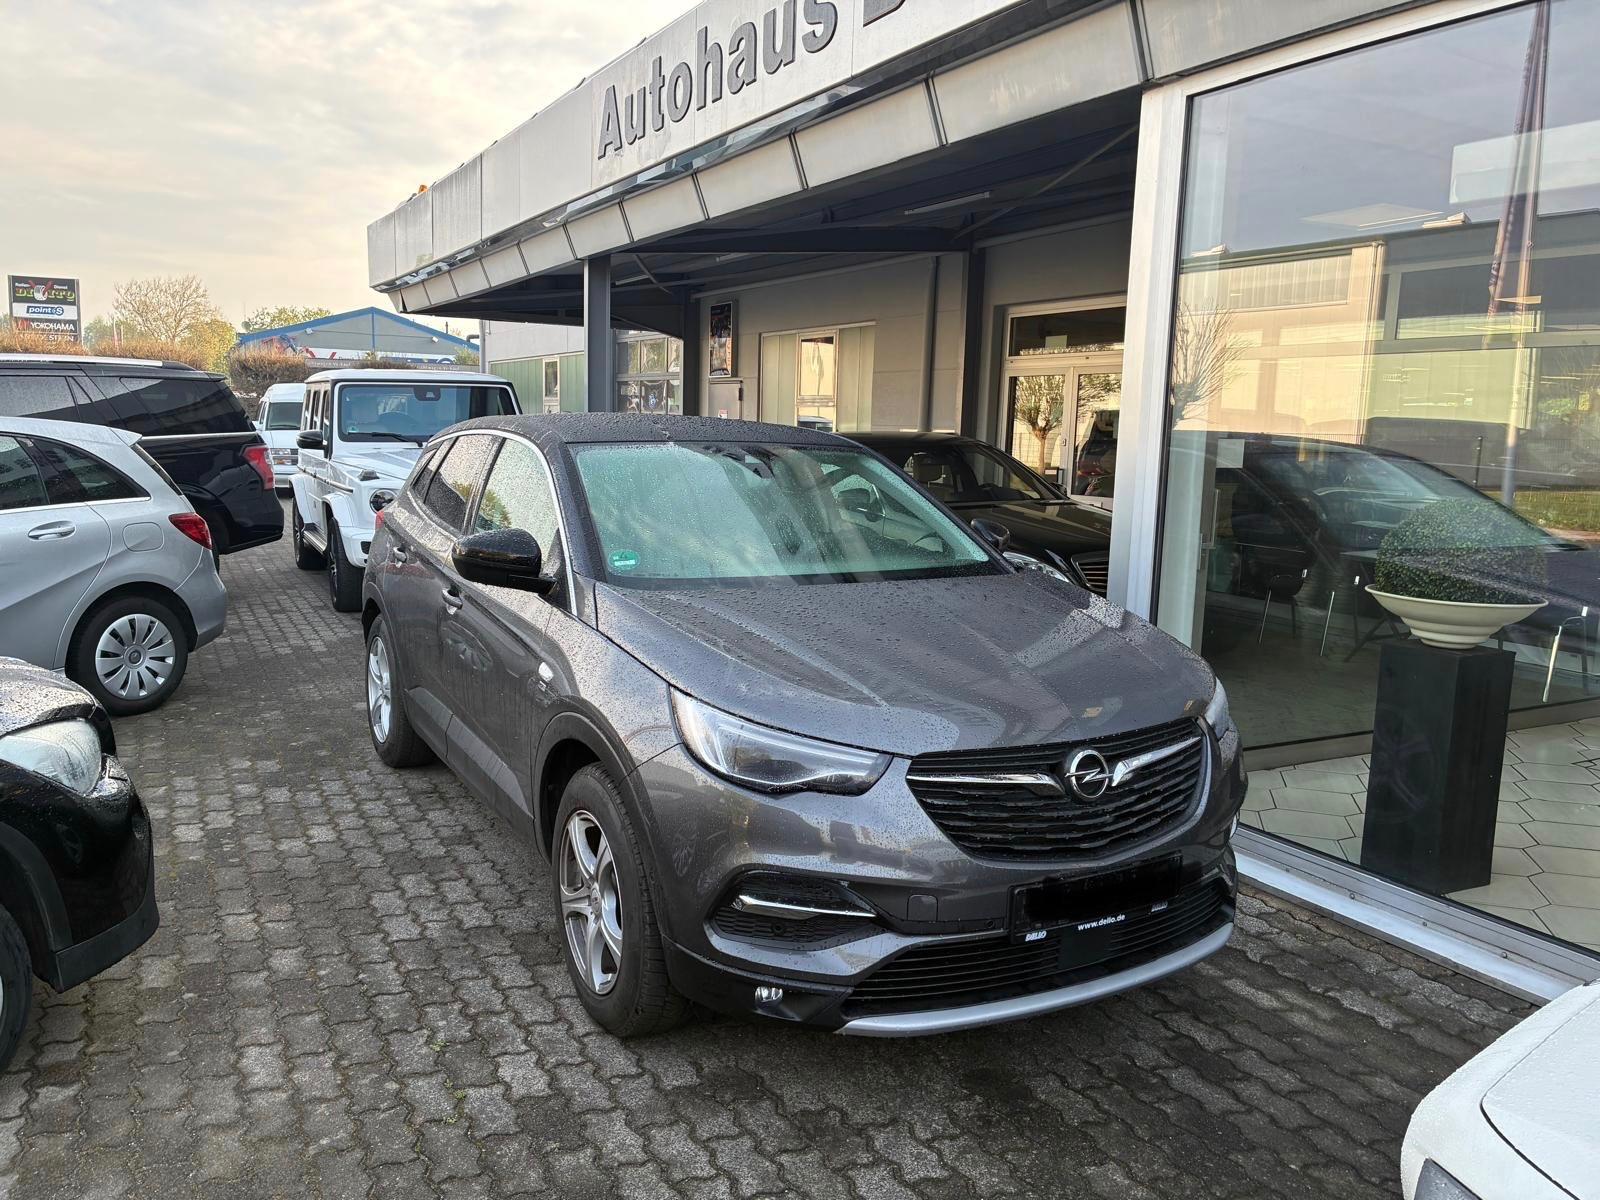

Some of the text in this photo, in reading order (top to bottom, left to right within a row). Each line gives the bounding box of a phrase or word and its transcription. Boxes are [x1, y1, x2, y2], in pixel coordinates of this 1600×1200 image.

[598, 0, 838, 160] Autohaus
[31, 322, 75, 331] YOKOHAMA
[1077, 913, 1126, 931] www.dello.de
